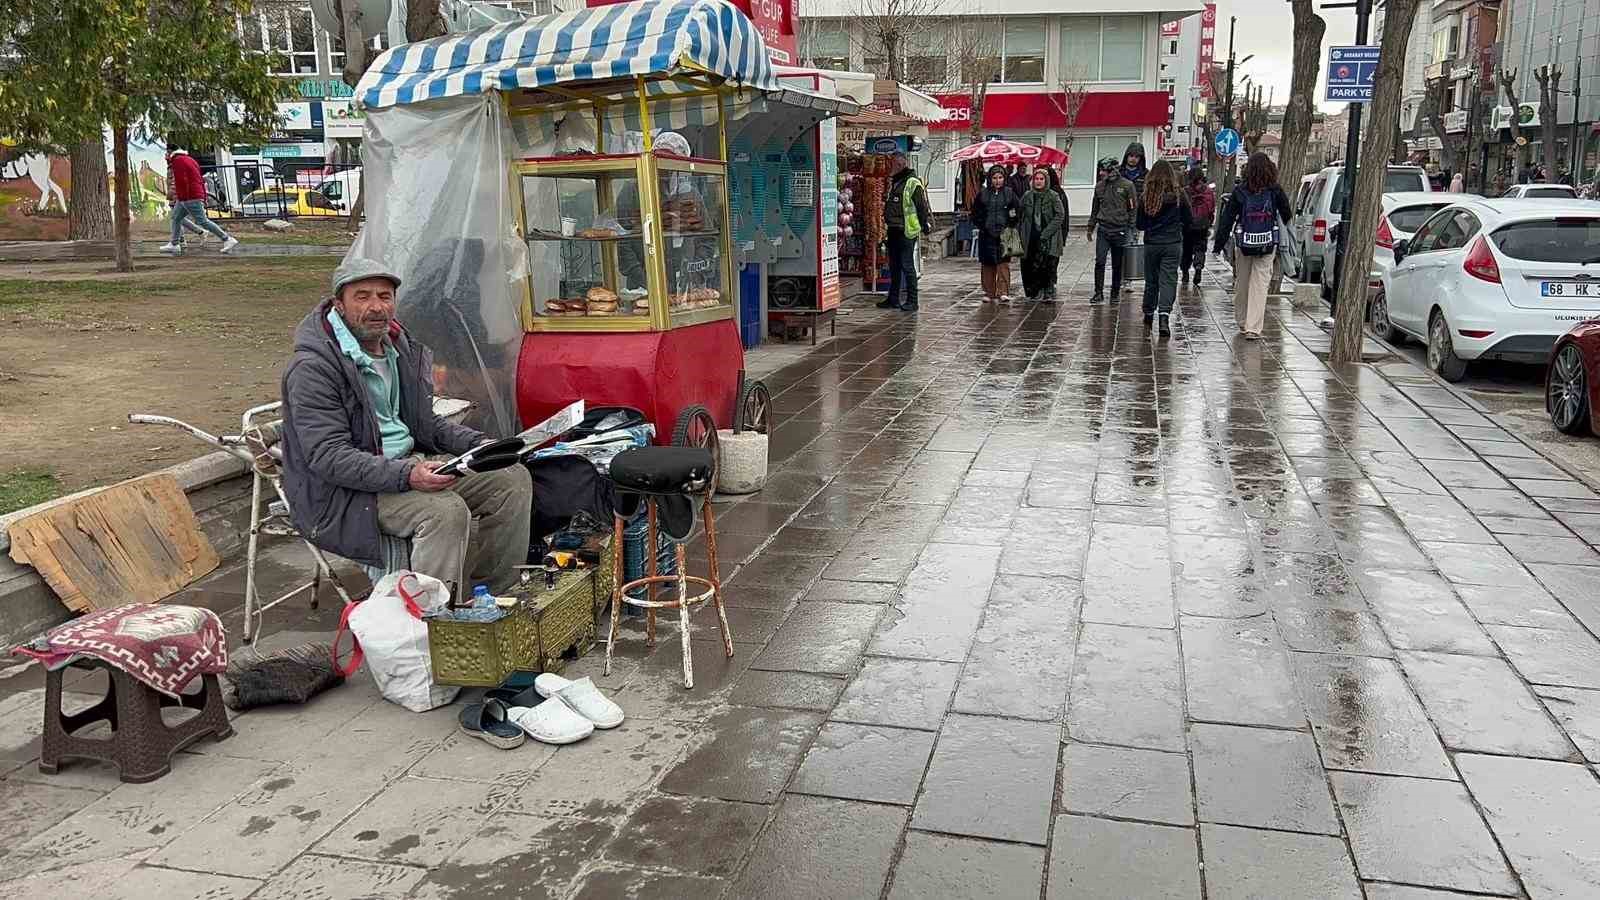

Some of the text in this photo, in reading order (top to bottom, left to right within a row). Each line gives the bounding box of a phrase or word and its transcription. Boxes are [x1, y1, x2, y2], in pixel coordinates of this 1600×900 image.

[1201, 27, 1215, 75] MHP
[1332, 88, 1372, 97] PARK YE
[1549, 284, 1563, 295] 68
[1576, 284, 1589, 295] HK
